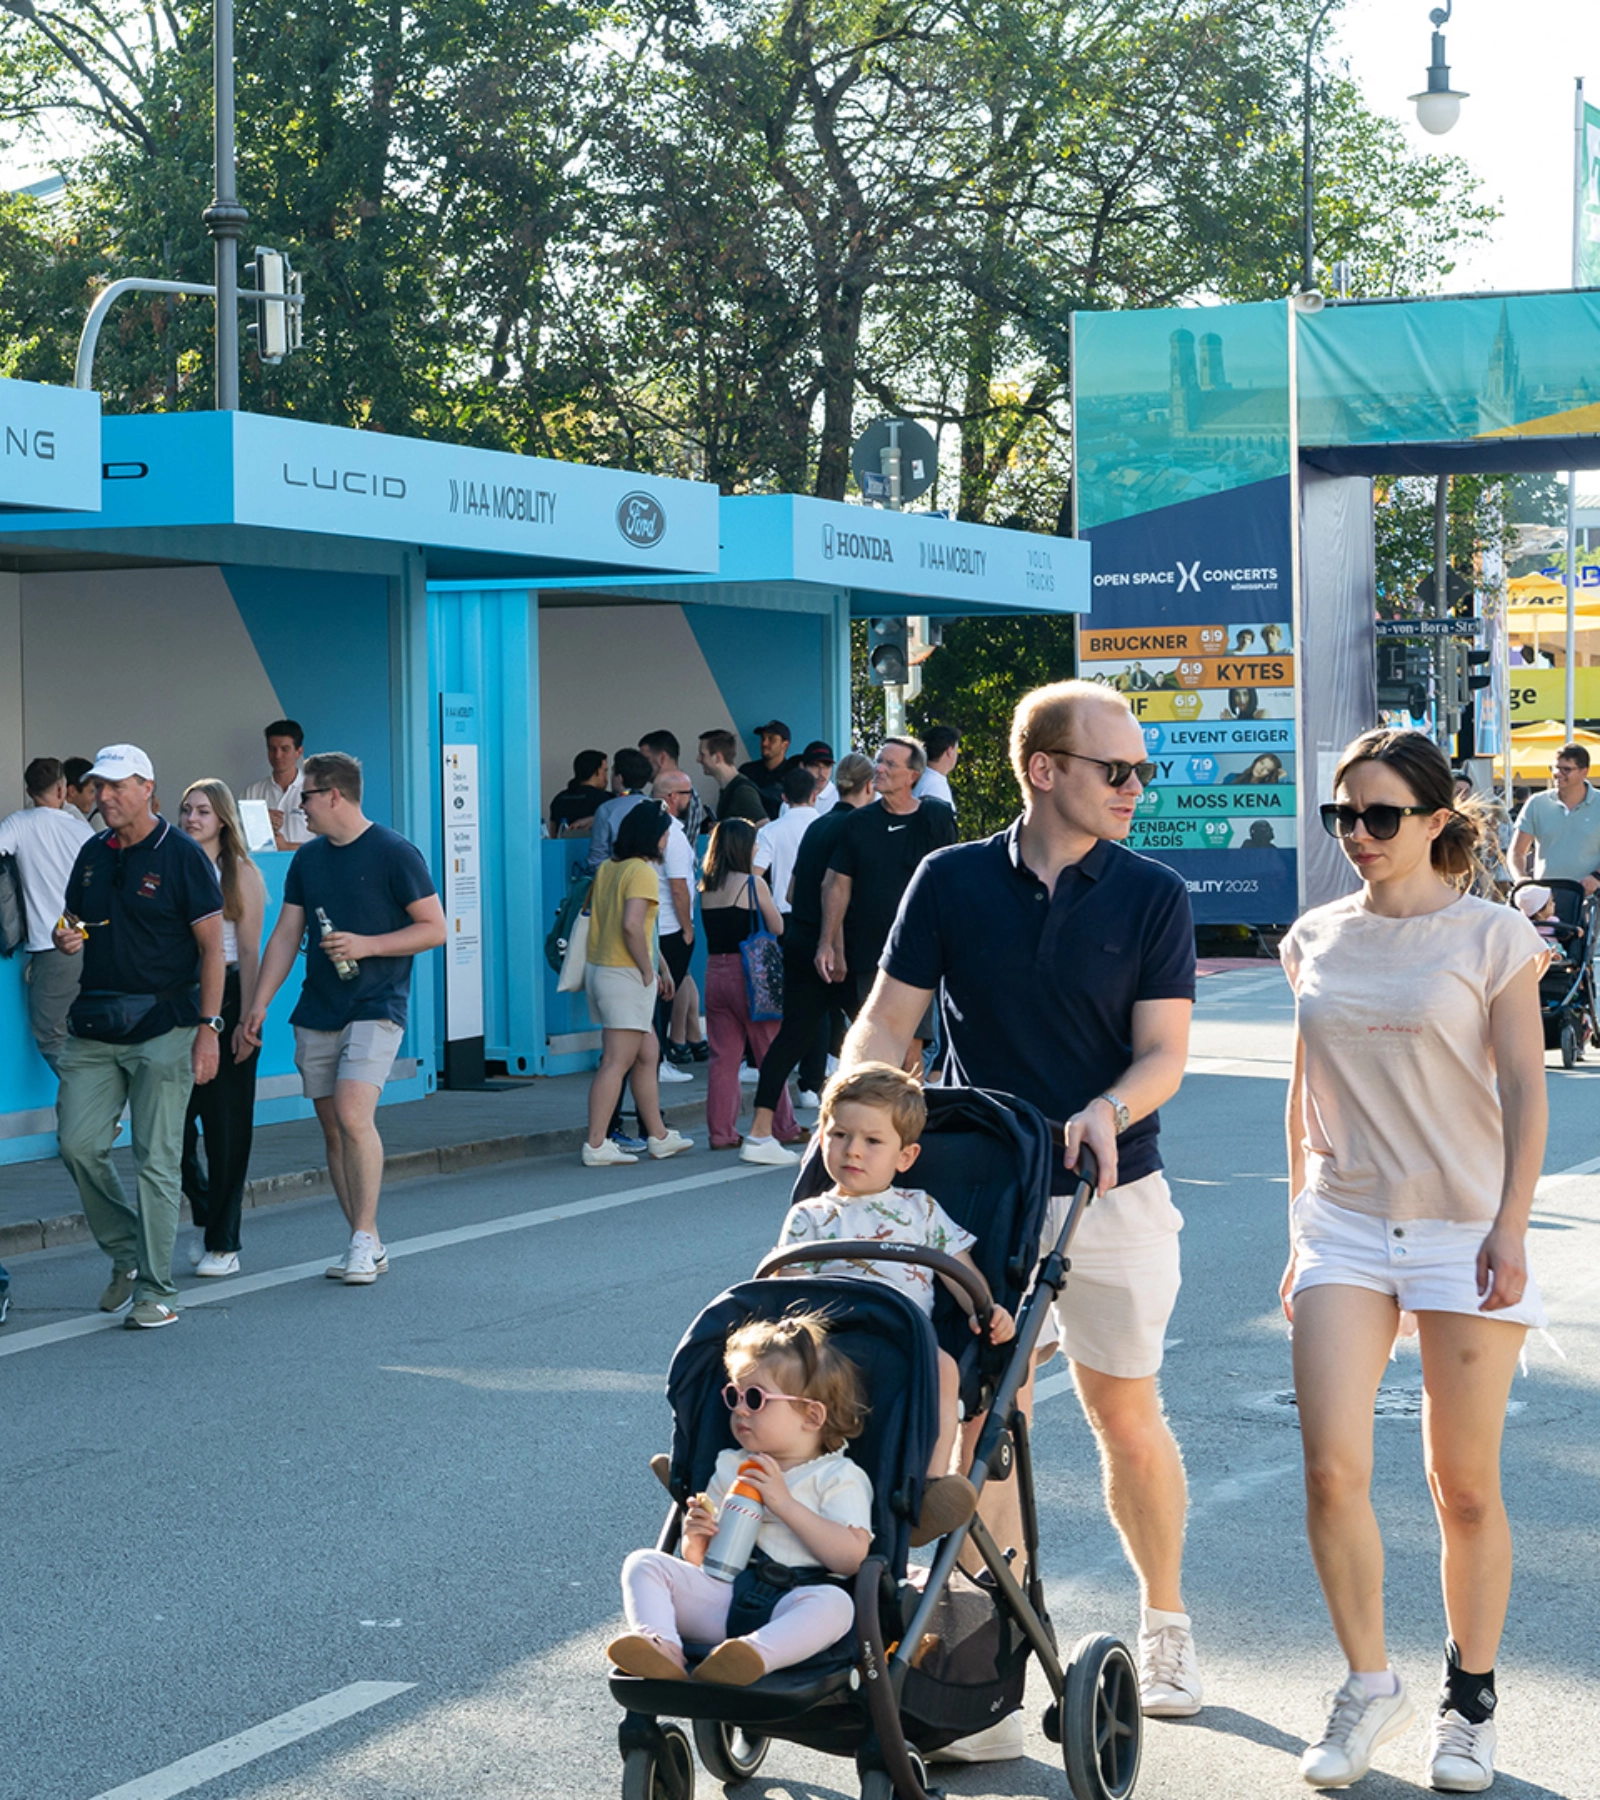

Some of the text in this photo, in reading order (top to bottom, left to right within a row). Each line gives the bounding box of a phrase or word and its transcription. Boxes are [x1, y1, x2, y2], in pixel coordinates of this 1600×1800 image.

[284, 462, 406, 499] LUCID
[463, 480, 557, 525] IAA MOBILITY
[622, 498, 659, 540] Ford
[837, 533, 894, 563] HONDA
[927, 543, 988, 576] IAA MOBILITY
[1026, 571, 1055, 592] TRUCKS
[1093, 572, 1129, 587] OPEN
[1133, 571, 1174, 585] SPACE
[1203, 568, 1278, 582] CONCERTS
[1090, 634, 1187, 652] BRUCKNER
[1217, 663, 1284, 681] KYTES
[1171, 730, 1289, 744] LEVENT GEIGER
[1177, 794, 1282, 809] MOSS KENA
[1185, 880, 1259, 893] BILITY 2023
